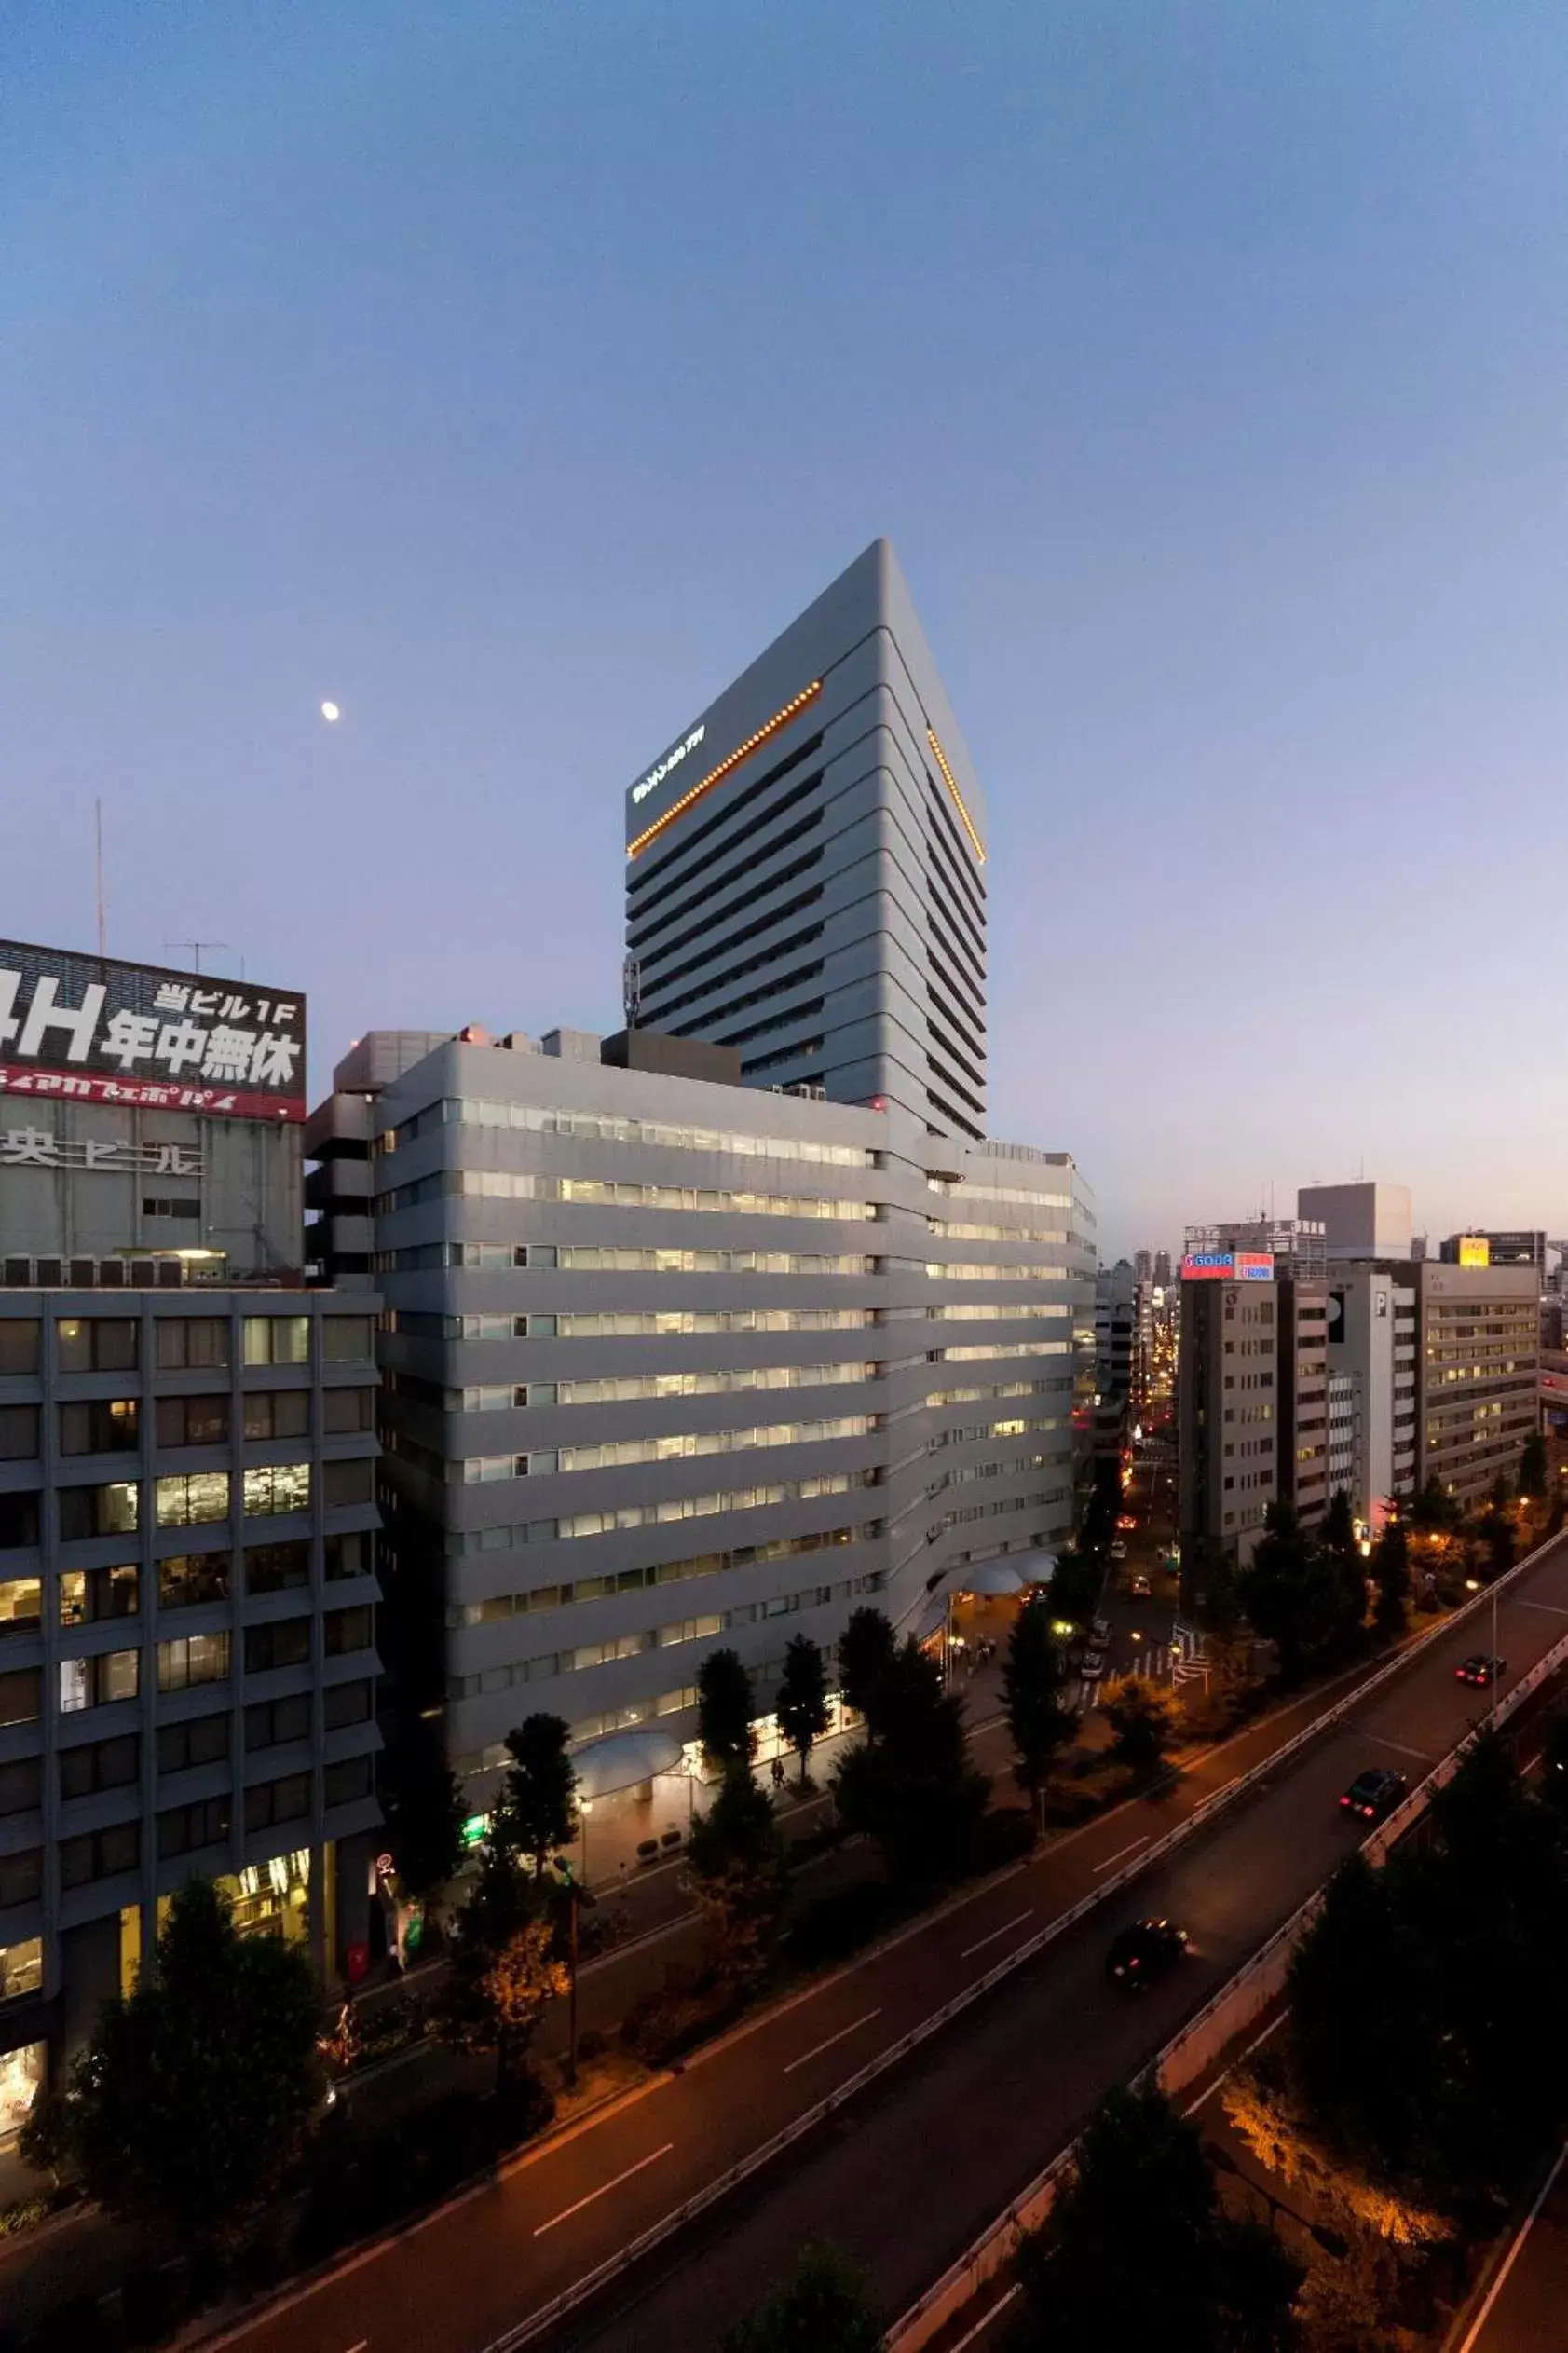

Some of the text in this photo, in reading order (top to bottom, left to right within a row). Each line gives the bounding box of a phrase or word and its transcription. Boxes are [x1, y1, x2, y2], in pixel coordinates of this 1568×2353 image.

[153, 983, 297, 1024] 当ビル1F
[100, 1009, 301, 1085] 年中無休
